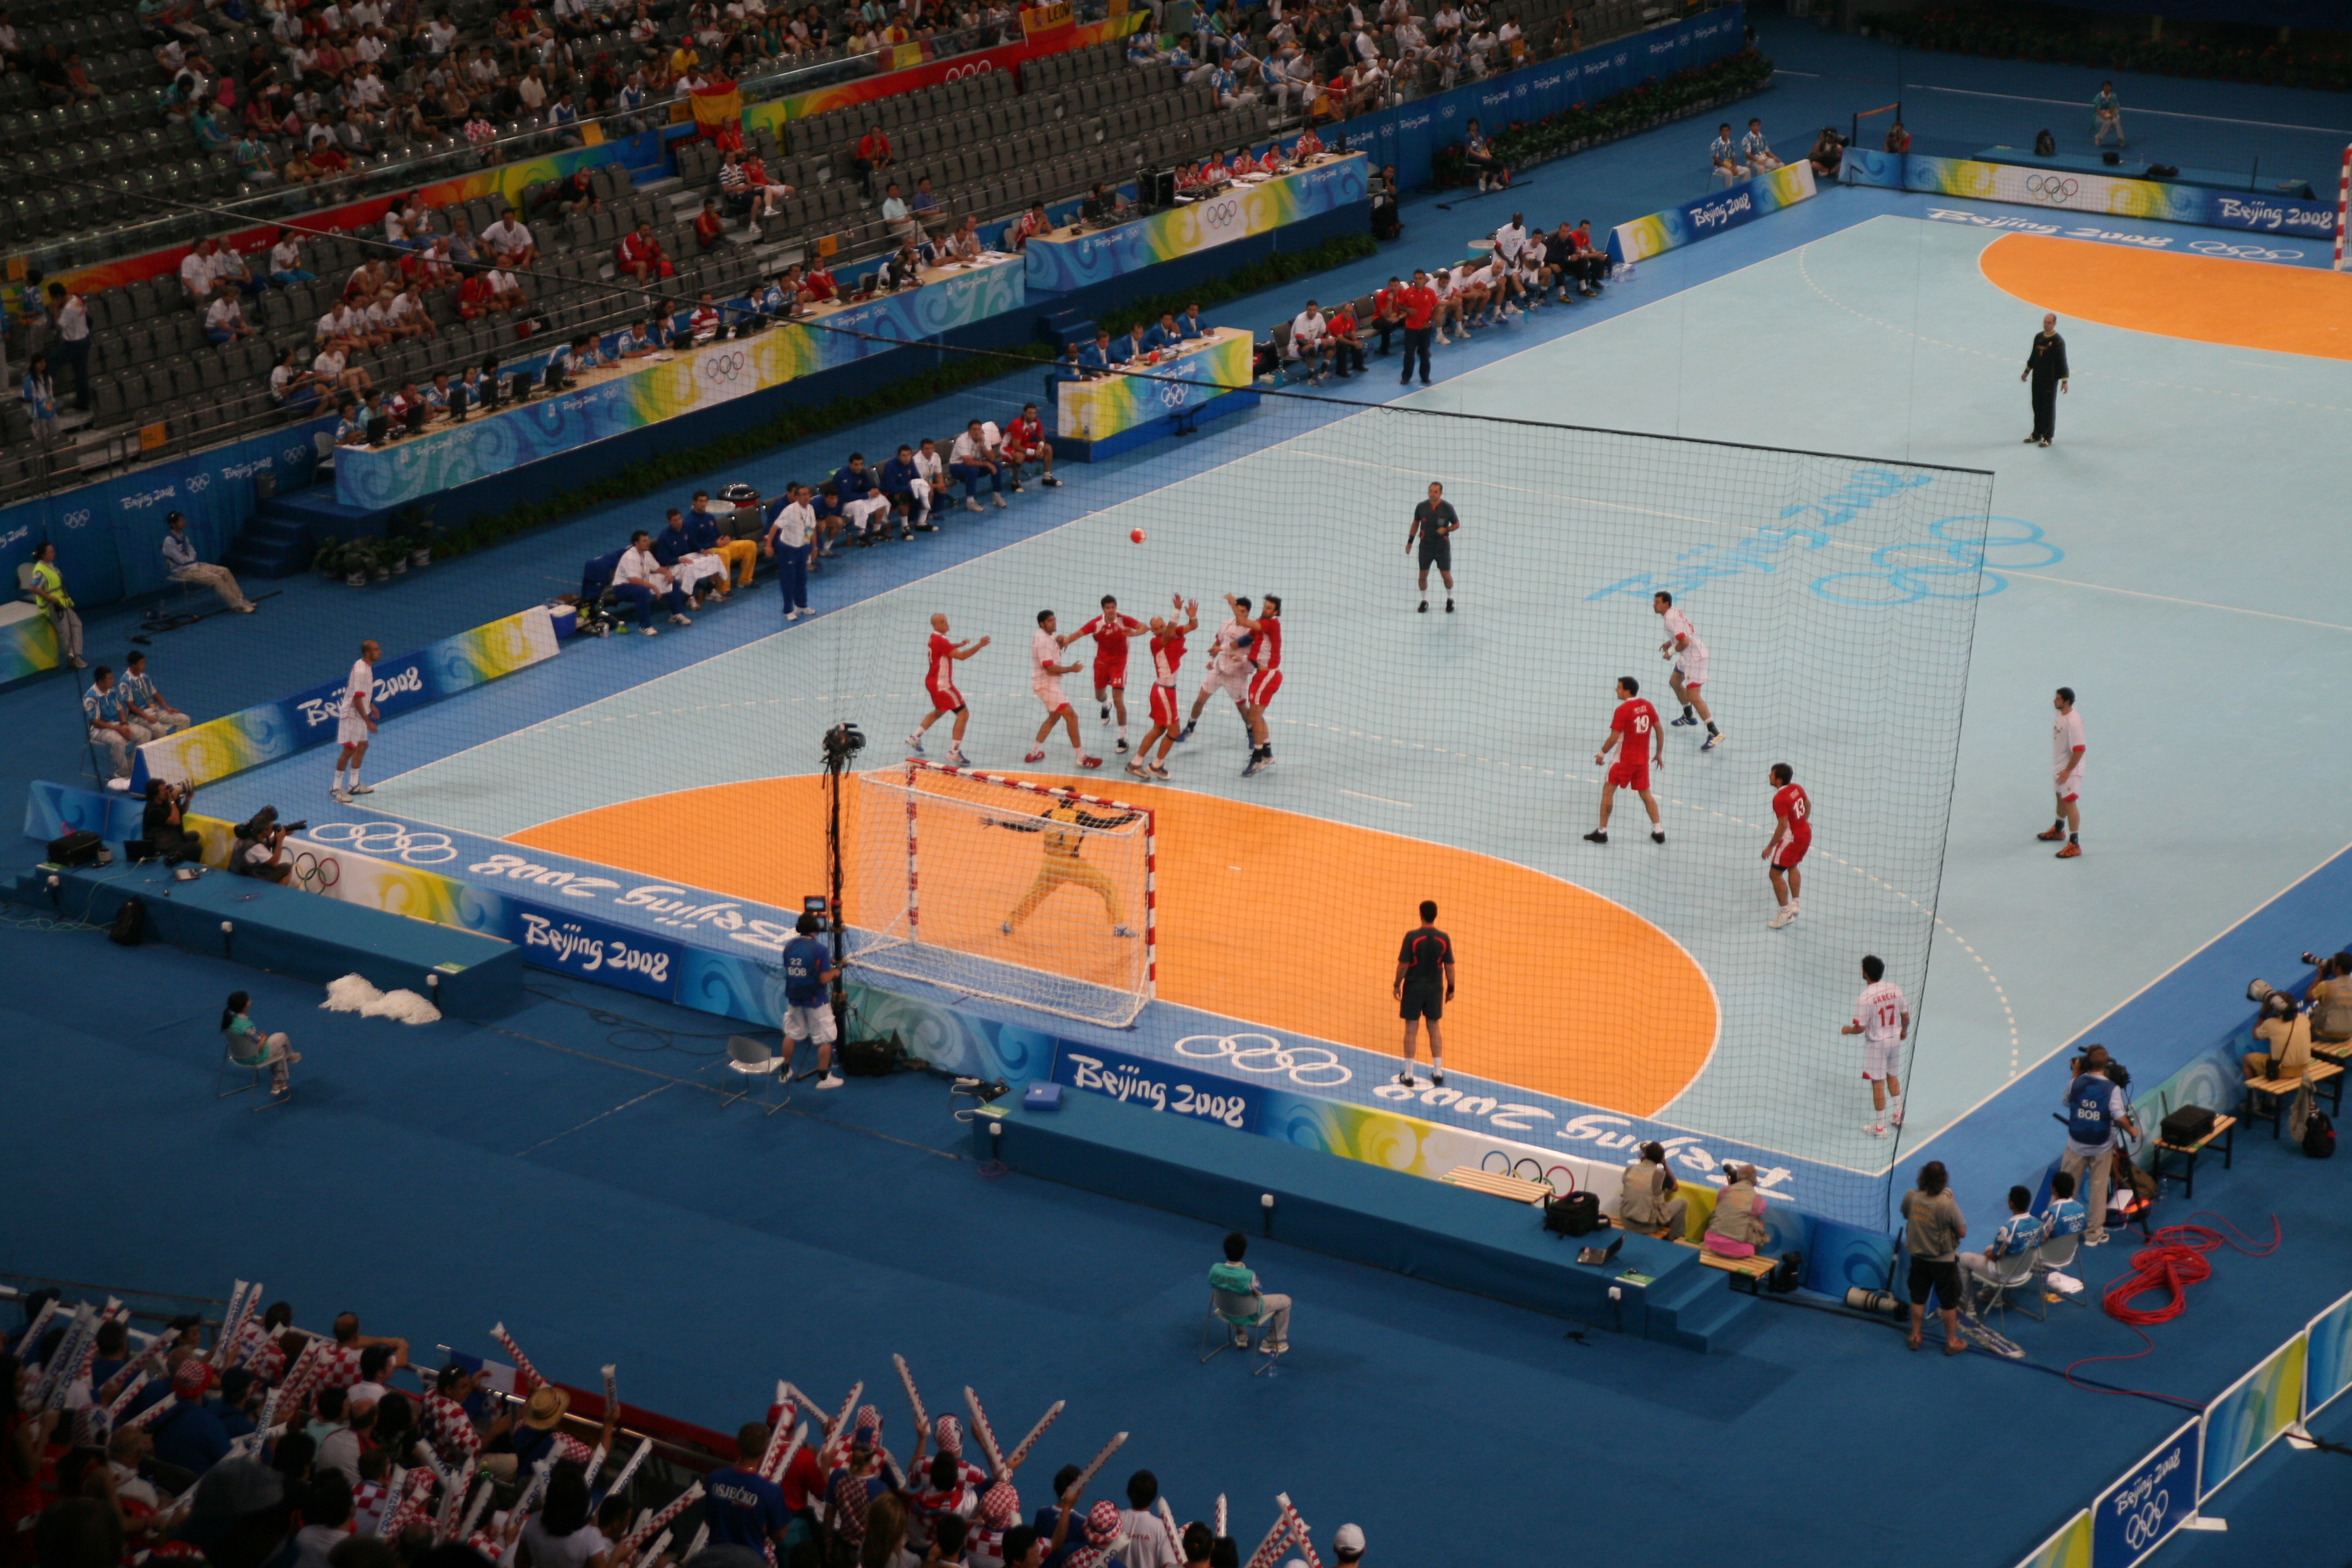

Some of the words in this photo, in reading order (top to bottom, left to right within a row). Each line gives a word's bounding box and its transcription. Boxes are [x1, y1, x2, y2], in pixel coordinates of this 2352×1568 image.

[1690, 201, 1727, 227] Beijing
[1726, 192, 1751, 215] 2008
[2218, 197, 2286, 228] Beijing
[2286, 207, 2333, 229] 2008
[1927, 207, 2062, 235] Beijing
[2064, 227, 2175, 247] 2008
[221, 463, 253, 480] Beijing
[252, 457, 273, 472] 2008
[121, 492, 154, 510] Beijing
[153, 485, 175, 501] 2008
[7, 524, 28, 541] 2008
[373, 666, 423, 702] 2008
[1634, 714, 1650, 733] 19
[1793, 797, 1806, 819] 13
[468, 854, 621, 897] 2008
[615, 884, 800, 951] Beijing
[520, 913, 604, 969] Beijing
[606, 941, 670, 982] 2008
[788, 967, 808, 976] BOB
[1878, 1004, 1895, 1027] 17
[1068, 1053, 1167, 1111] Beijing
[1170, 1084, 1246, 1128] 2008
[2082, 1099, 2097, 1109] 50
[2077, 1108, 2101, 1122] BOB
[2114, 1474, 2153, 1516] Beijing
[2154, 1446, 2181, 1485] 2008
[380, 1489, 402, 1534] CROATIA
